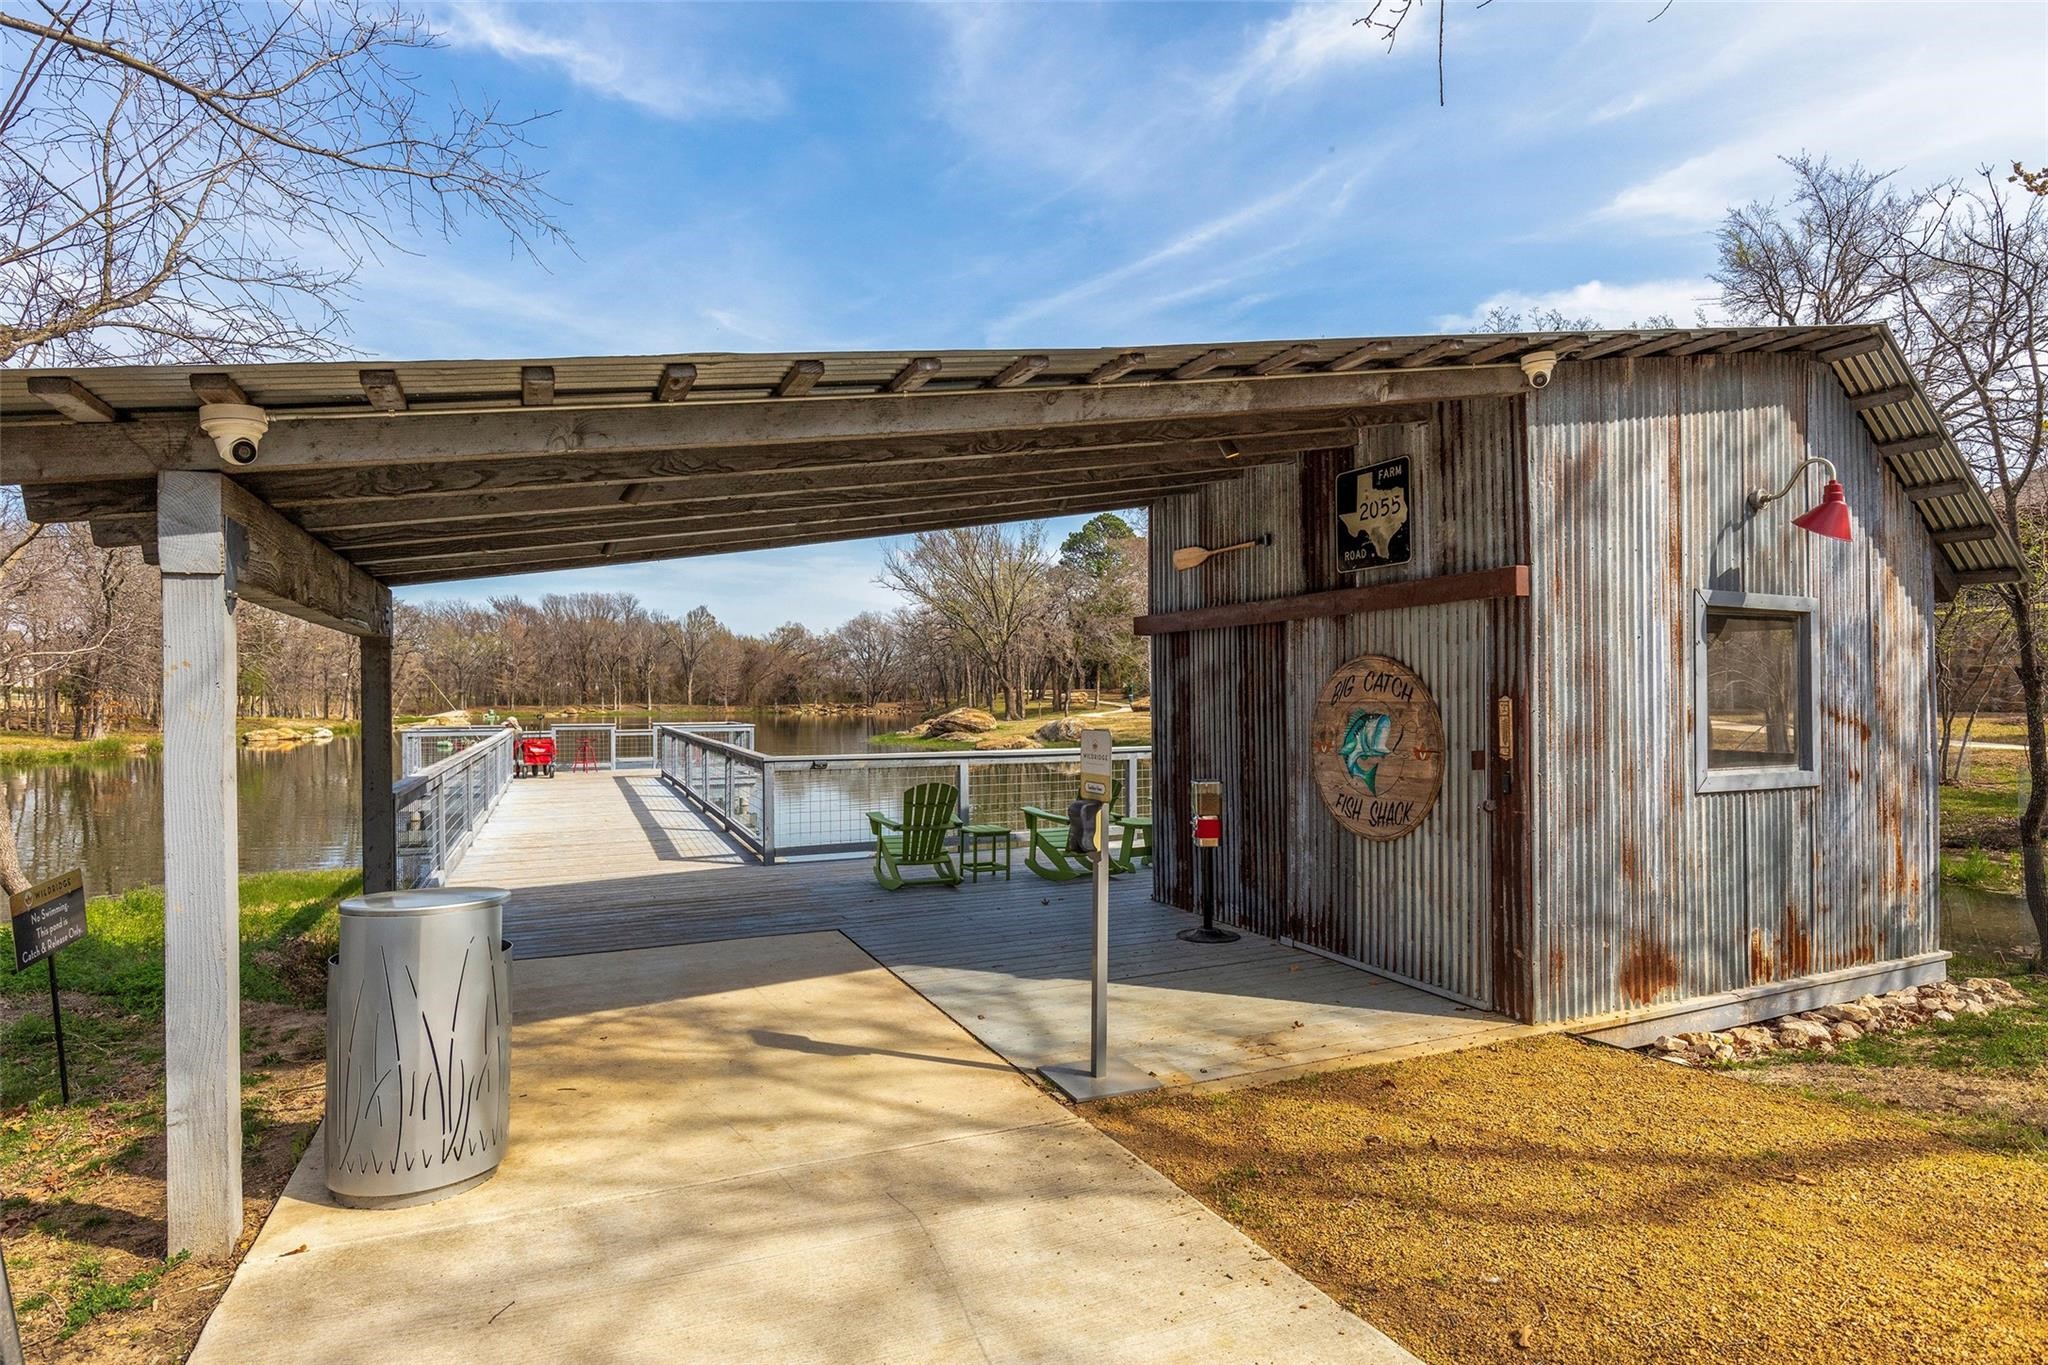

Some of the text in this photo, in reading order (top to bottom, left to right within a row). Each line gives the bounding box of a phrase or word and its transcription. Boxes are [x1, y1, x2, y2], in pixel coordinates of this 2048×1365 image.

[1378, 464, 1402, 480] FARM
[1360, 495, 1401, 522] 2055
[1344, 548, 1367, 561] ROAD
[1331, 670, 1414, 706] BIG CATCH
[1083, 753, 1108, 761] WILDRIDGE
[1335, 793, 1414, 828] FISH SHACK
[35, 879, 71, 898] WILDRIDGE
[31, 912, 41, 925] No
[36, 917, 69, 940] This pond is
[22, 946, 41, 964] Catch
[41, 943, 47, 954] &
[47, 934, 68, 950] Release
